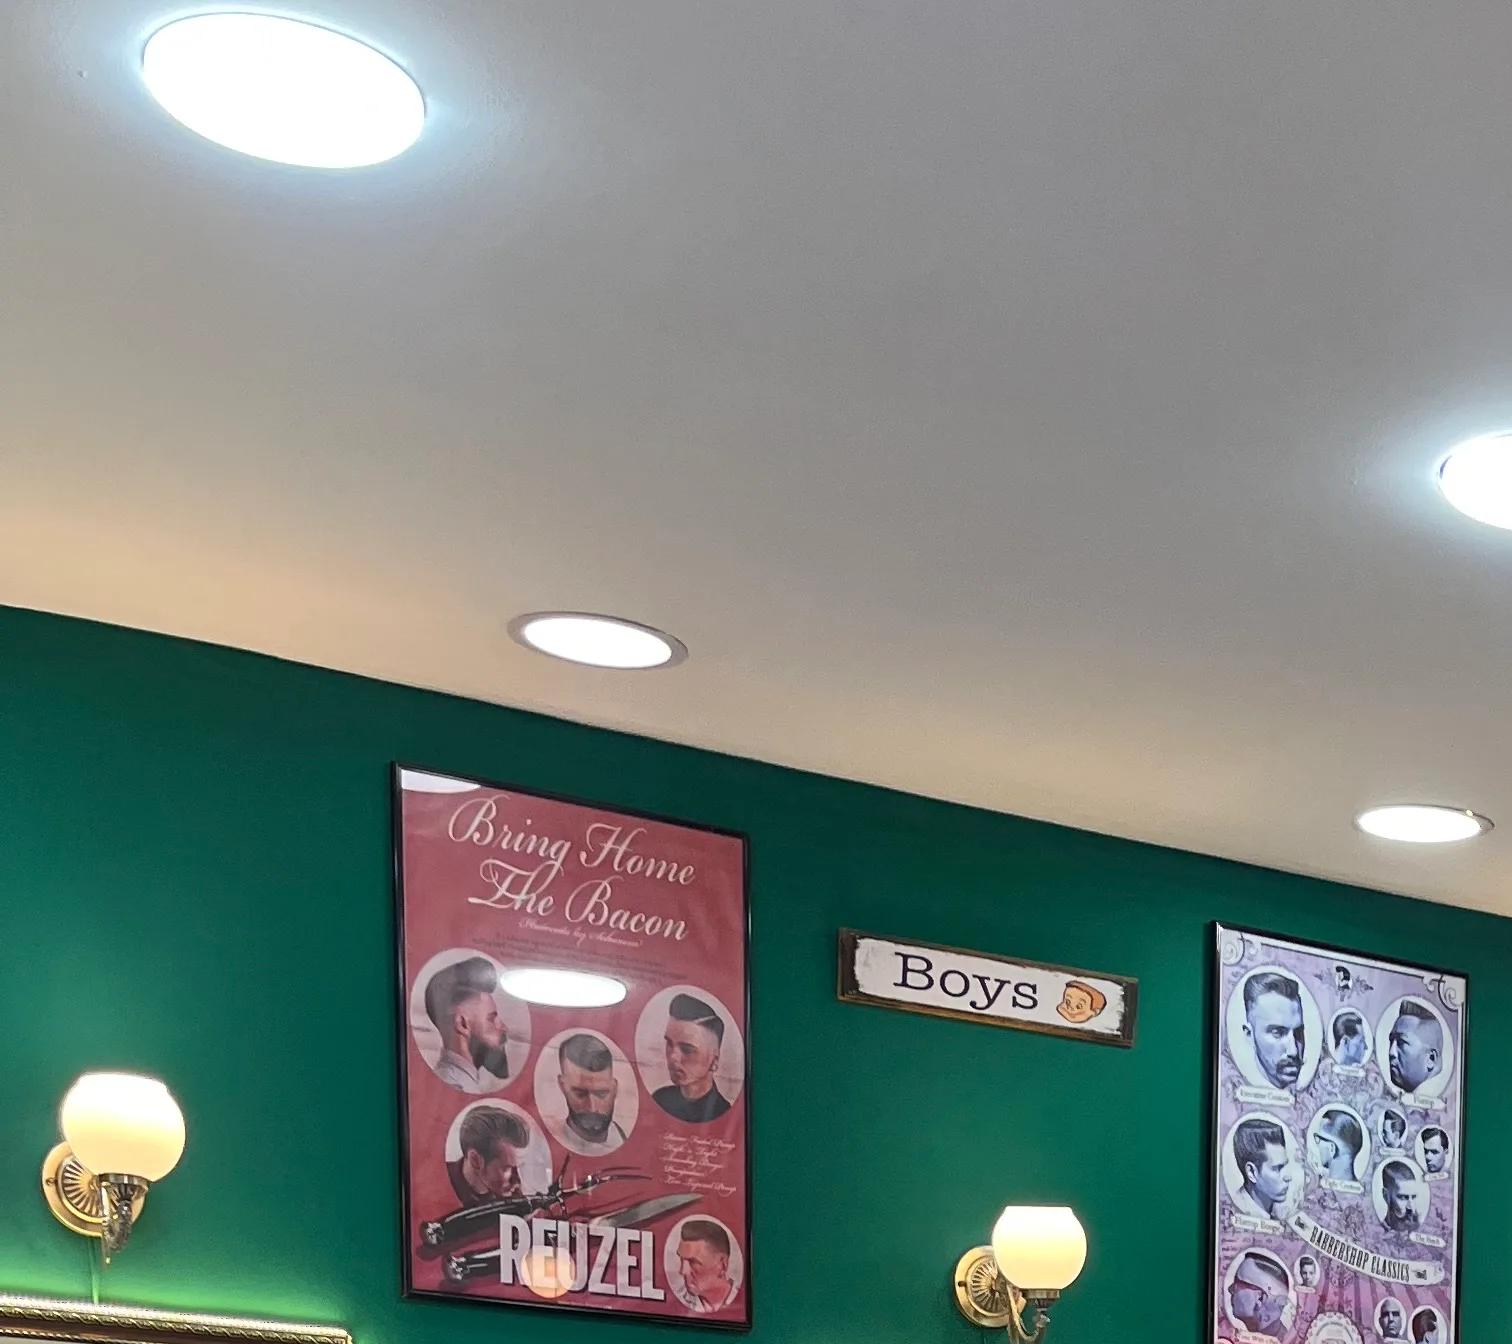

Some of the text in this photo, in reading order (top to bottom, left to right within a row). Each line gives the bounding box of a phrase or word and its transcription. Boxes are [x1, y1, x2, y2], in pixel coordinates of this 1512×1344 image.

[448, 794, 697, 886] Bring Home
[468, 858, 689, 941] The Bacon
[893, 951, 1039, 1011] Boys
[498, 1212, 665, 1301] REUZEL
[1309, 1226, 1411, 1283] BARBERSHOP CLASSICS
